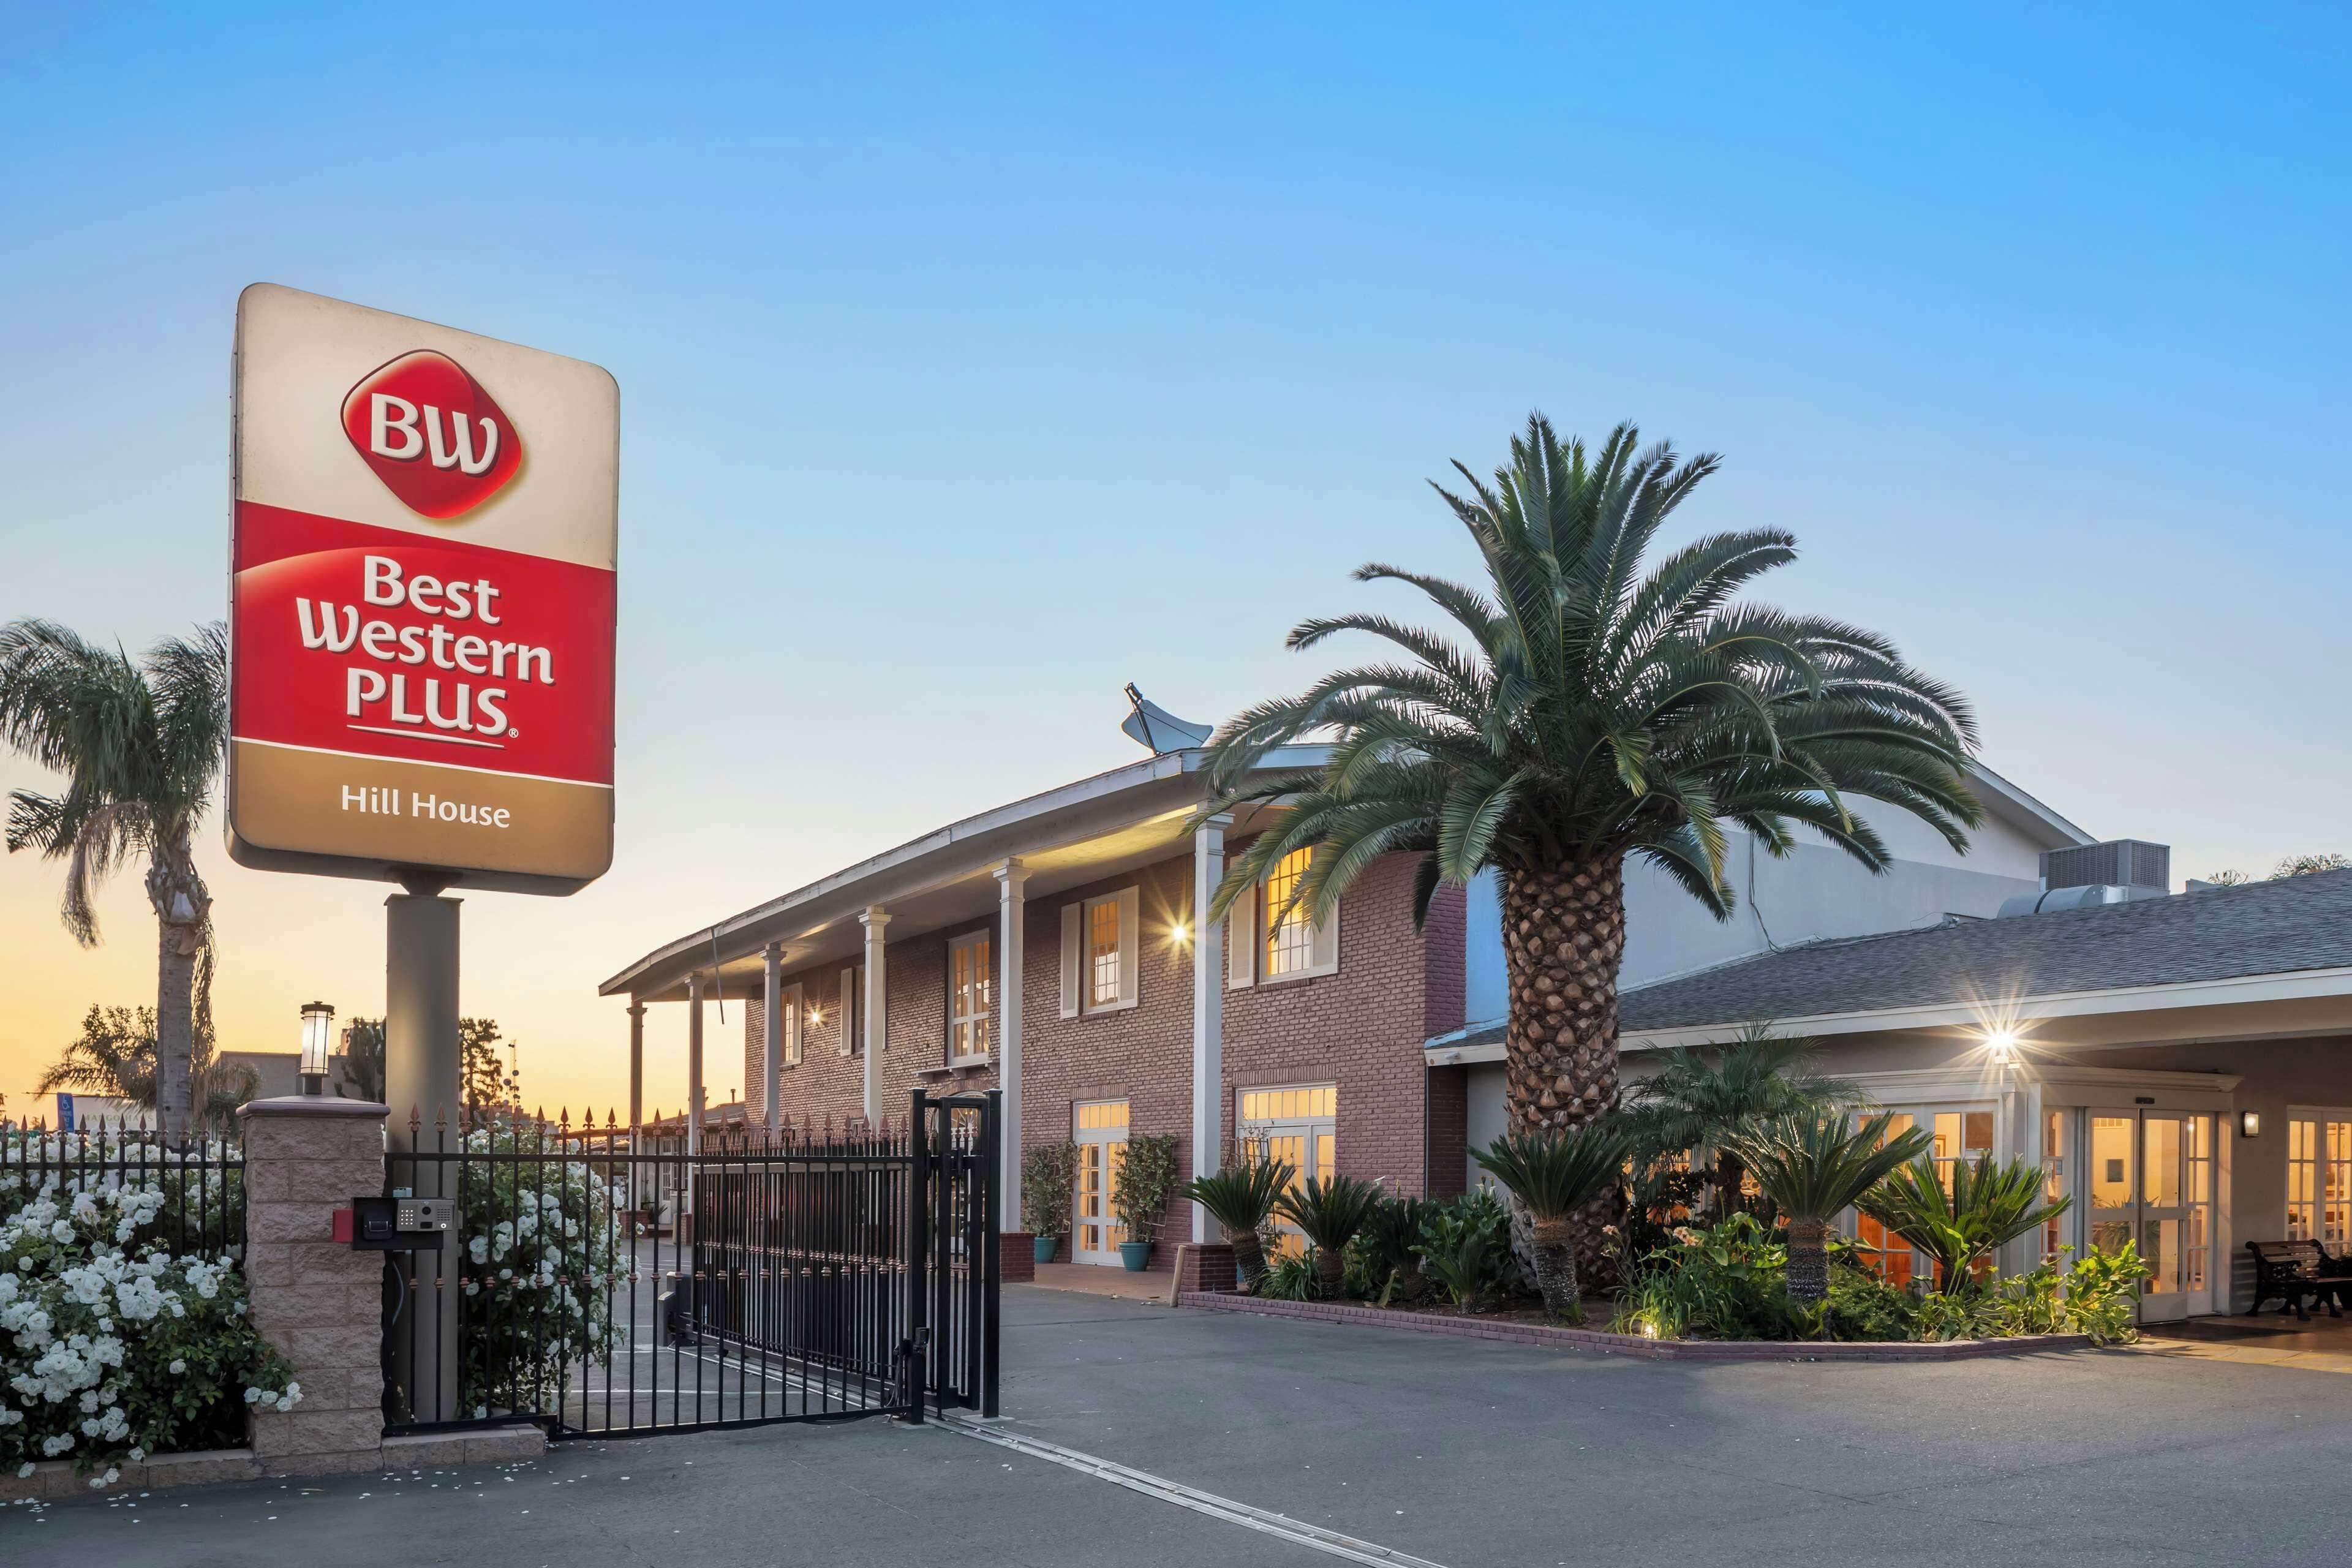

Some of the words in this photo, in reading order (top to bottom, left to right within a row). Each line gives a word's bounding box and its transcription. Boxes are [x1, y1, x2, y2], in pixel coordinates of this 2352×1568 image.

[371, 393, 498, 475] BW
[363, 555, 500, 625] Best
[296, 597, 555, 685] Western
[342, 785, 401, 816] Hill
[412, 792, 510, 829] House
